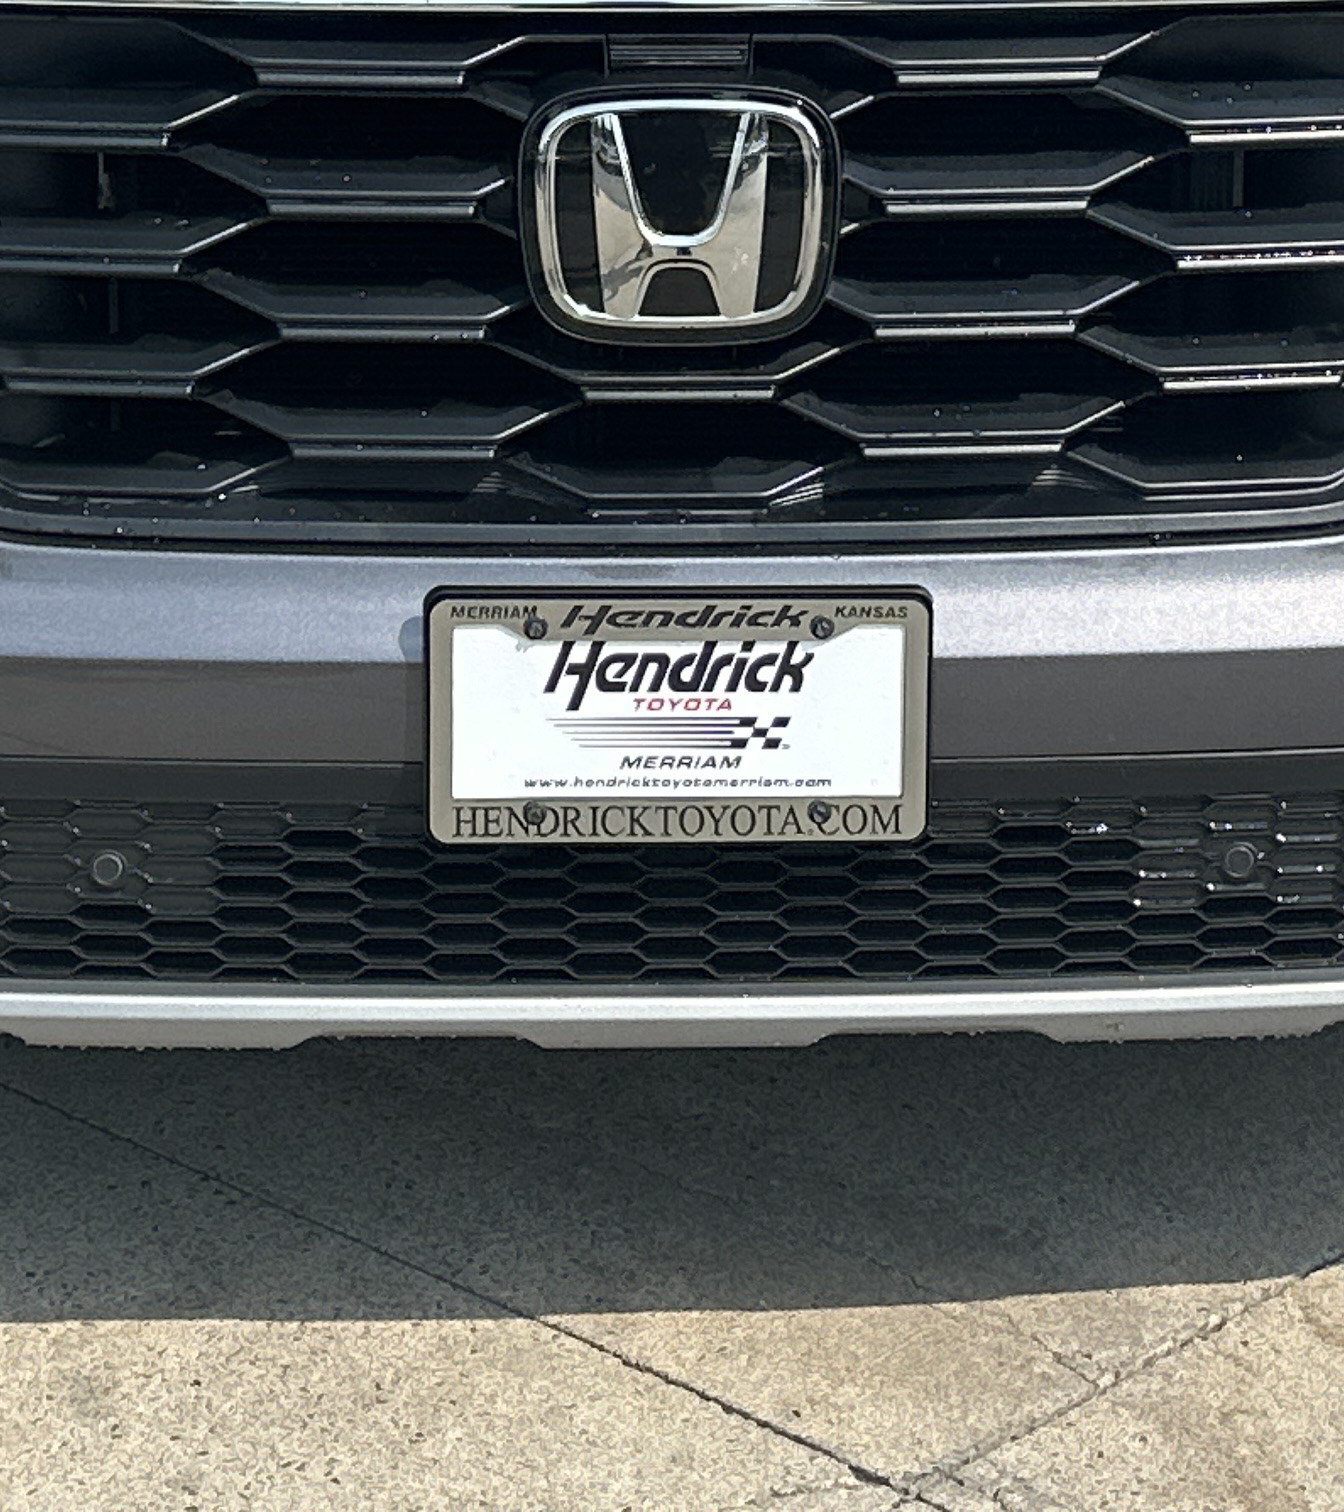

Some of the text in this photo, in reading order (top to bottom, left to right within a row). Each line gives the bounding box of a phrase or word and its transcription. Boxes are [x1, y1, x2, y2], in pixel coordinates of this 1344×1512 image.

[450, 604, 538, 620] MERRIAM
[559, 604, 810, 635] Hendrick
[834, 605, 909, 619] KANSAS
[543, 640, 815, 712] Hendrick
[632, 697, 733, 711] TOYOTA
[619, 755, 743, 770] MERRIAM
[452, 803, 904, 838] HENDRICKTOYOTA.COM
